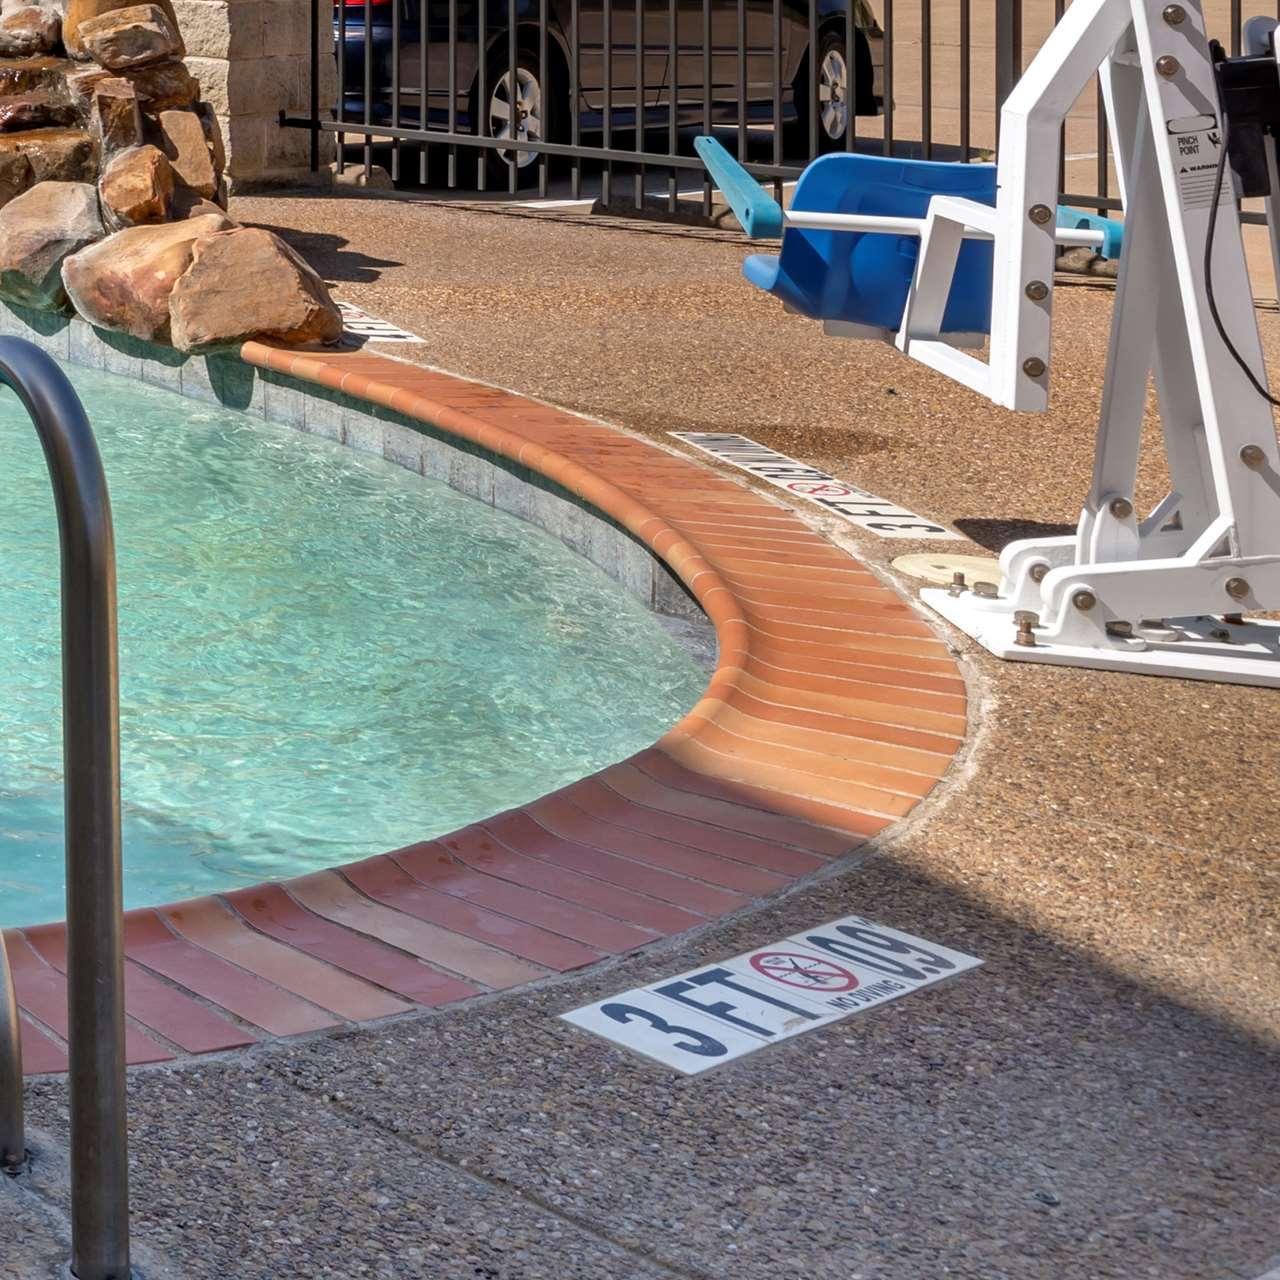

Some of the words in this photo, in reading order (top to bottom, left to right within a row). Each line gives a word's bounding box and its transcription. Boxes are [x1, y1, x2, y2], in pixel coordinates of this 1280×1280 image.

[1177, 135, 1199, 146] PINCH
[1179, 145, 1200, 156] POINT
[813, 497, 917, 518] FT
[866, 523, 946, 533] 3
[806, 925, 956, 980] 0.9
[653, 967, 821, 1038] FT
[826, 997, 861, 1011] NO
[849, 980, 906, 1003] DIVING
[600, 1002, 728, 1058] 3
